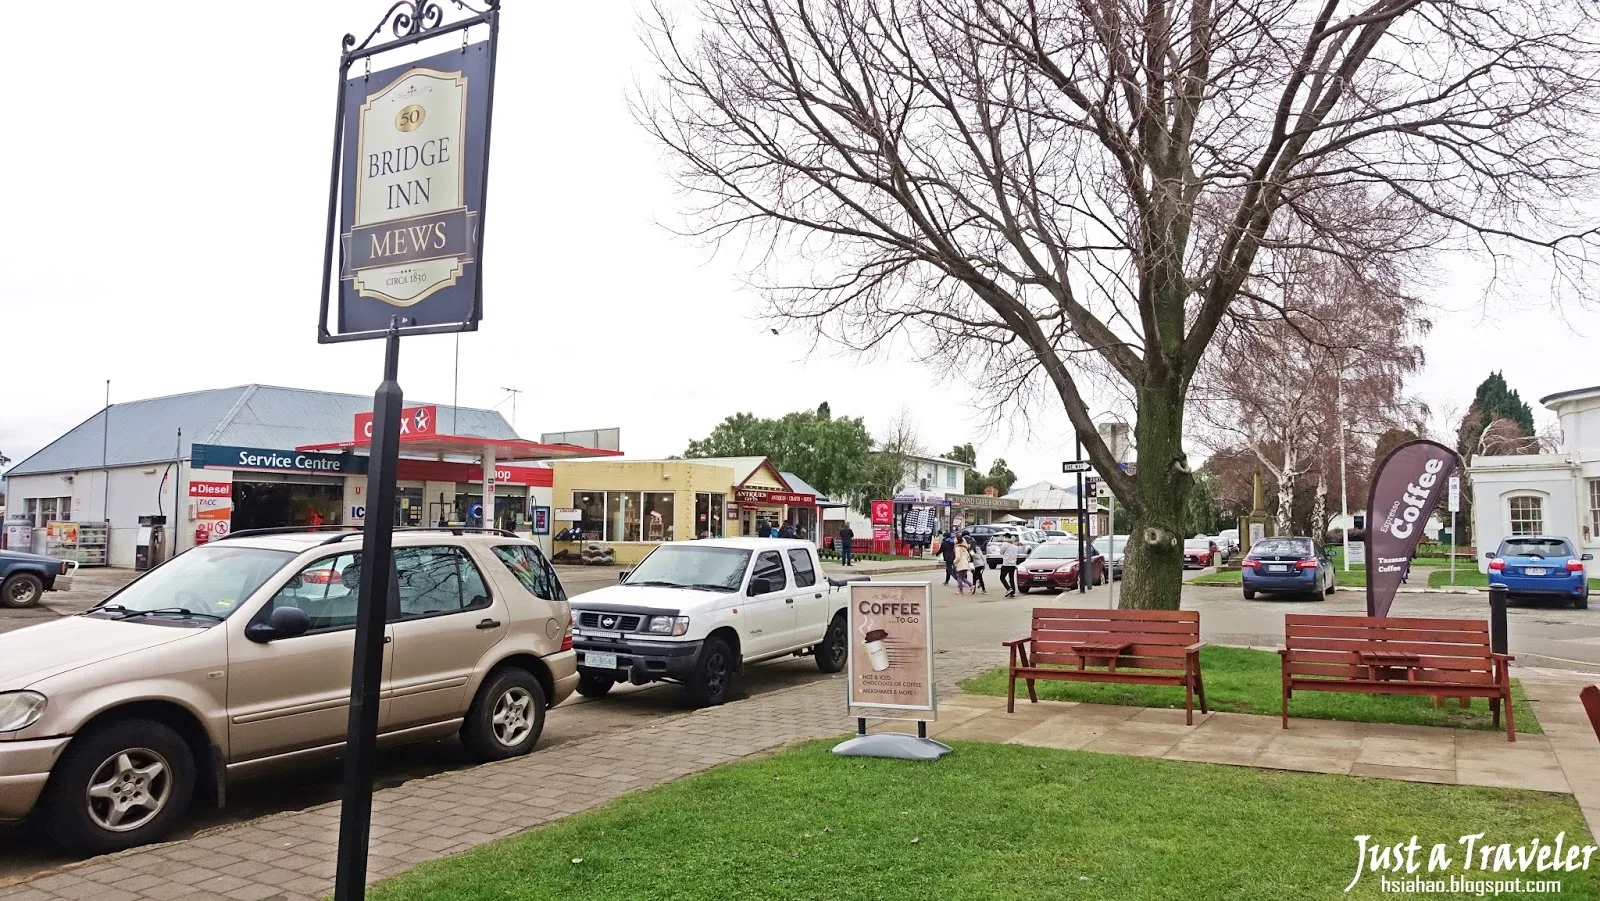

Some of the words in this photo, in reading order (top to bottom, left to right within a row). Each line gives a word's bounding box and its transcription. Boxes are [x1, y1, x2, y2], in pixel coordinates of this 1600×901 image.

[400, 109, 420, 127] 50
[368, 136, 450, 179] BRIDGE
[387, 177, 431, 210] INN
[369, 221, 446, 259] MEWS
[386, 275, 408, 286] CIRCA
[239, 451, 292, 468] Service
[295, 455, 341, 471] Centre
[198, 484, 229, 494] Diesel
[1391, 459, 1443, 539] Coffee
[352, 506, 365, 518] IC
[1380, 501, 1401, 533] Espresso
[1378, 556, 1407, 564] Tasman
[1378, 565, 1401, 573] Coffee
[859, 600, 920, 615] COFFEE
